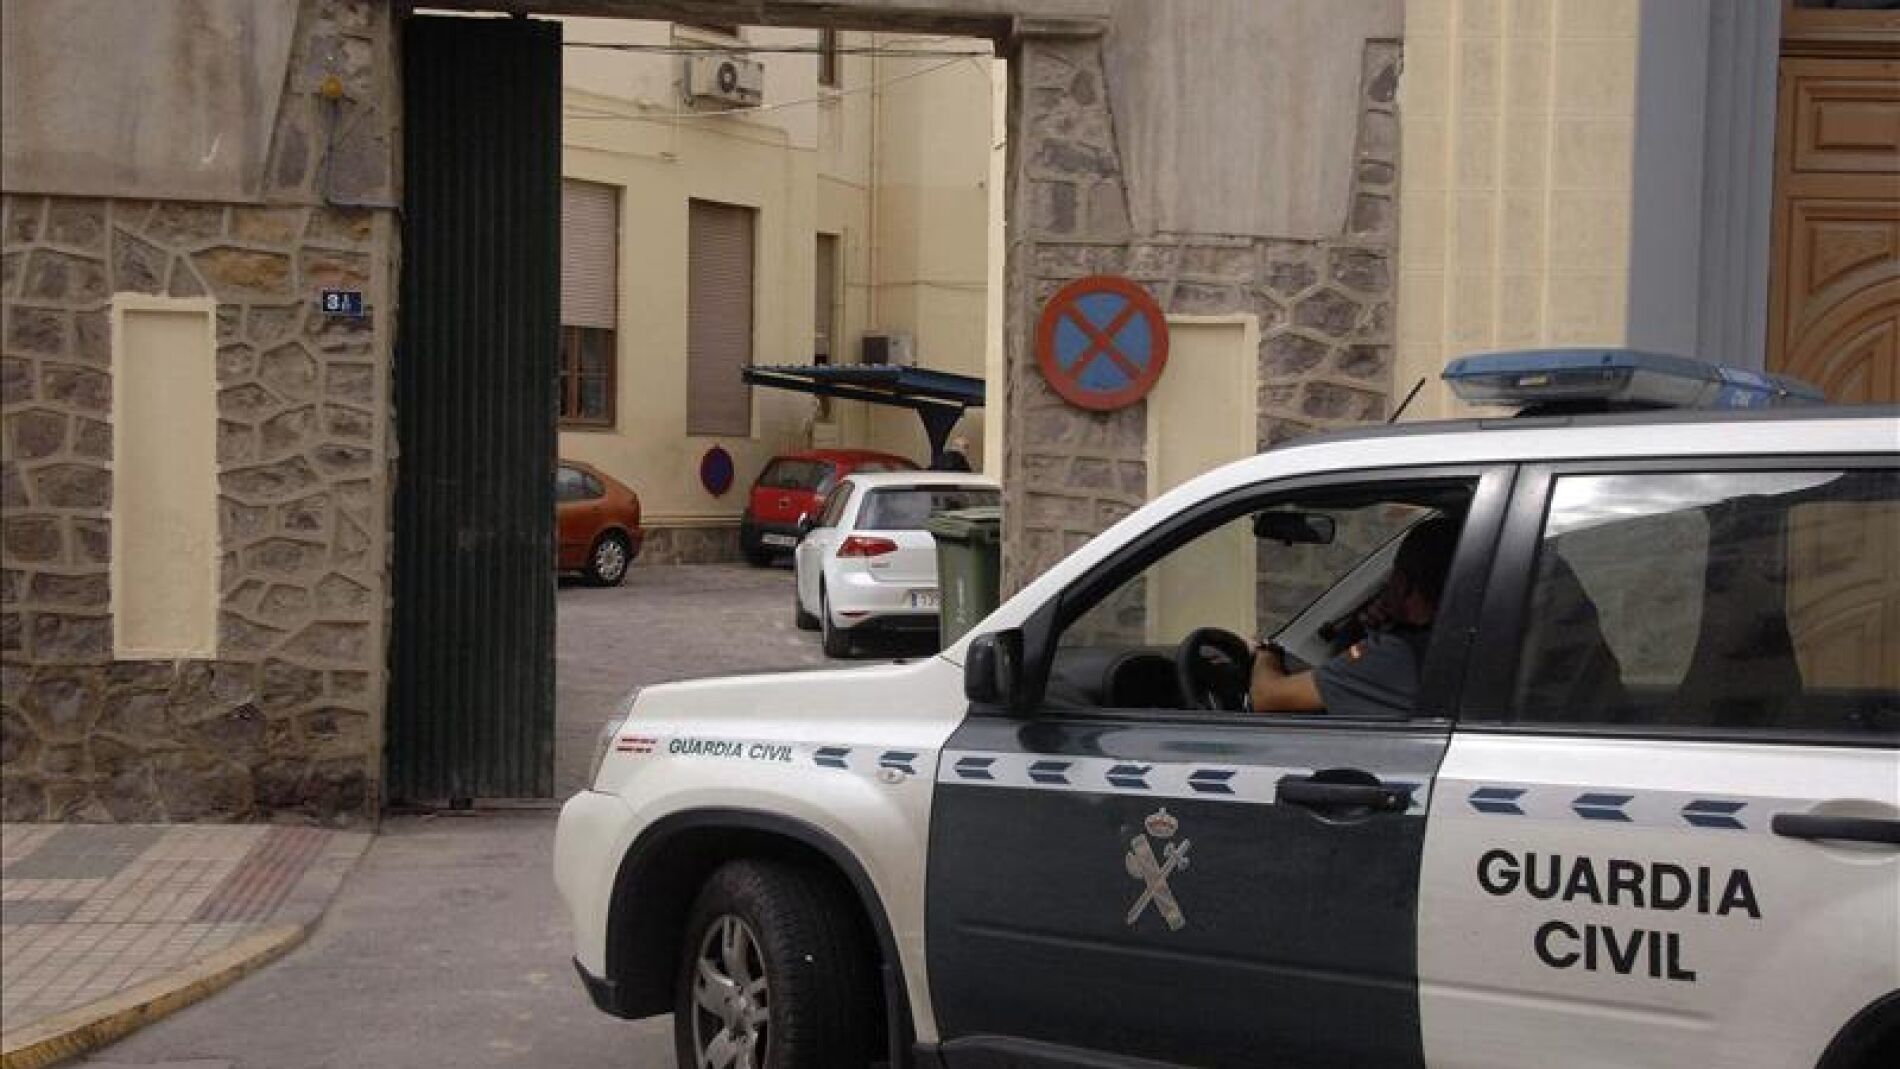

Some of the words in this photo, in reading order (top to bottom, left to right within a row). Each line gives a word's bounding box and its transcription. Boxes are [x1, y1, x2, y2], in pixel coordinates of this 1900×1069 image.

[669, 738, 742, 758] GUARDIA
[748, 743, 792, 762] CIVIL
[1477, 848, 1762, 919] GUARDIA
[1534, 920, 1697, 982] CIVIL
